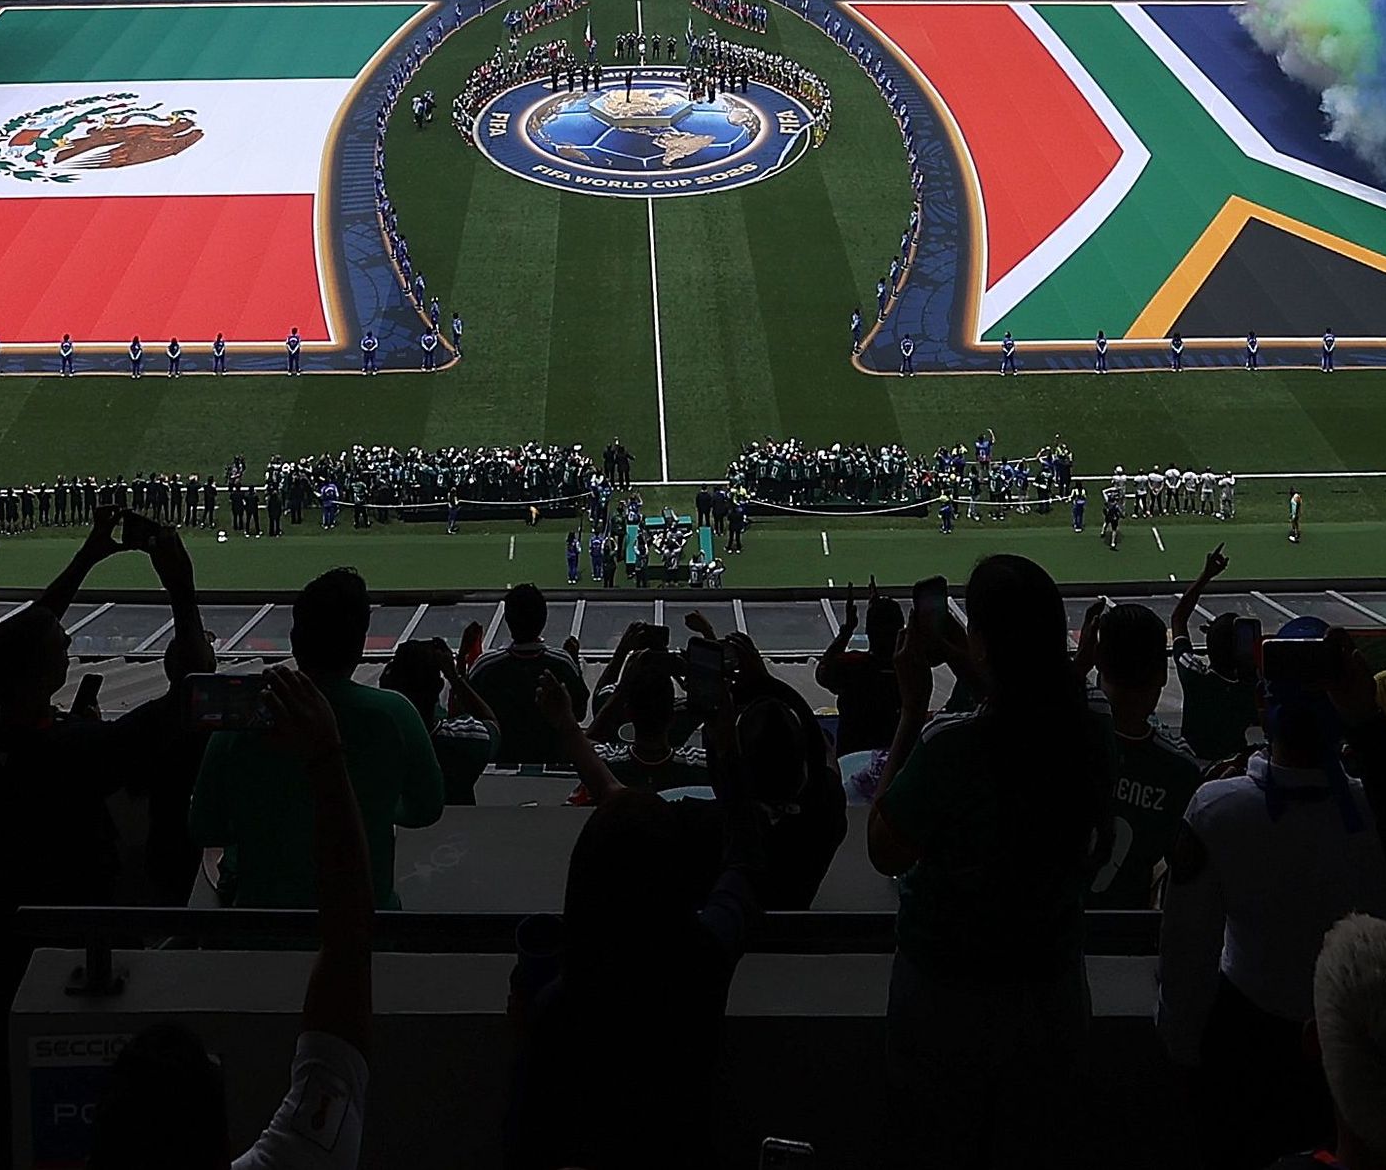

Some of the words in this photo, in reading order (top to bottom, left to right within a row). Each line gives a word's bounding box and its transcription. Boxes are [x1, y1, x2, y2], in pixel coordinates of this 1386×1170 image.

[489, 111, 511, 139] FIFA
[778, 109, 801, 135] FIFA
[532, 164, 572, 183] FIFA
[574, 175, 649, 191] WORLD
[652, 177, 694, 190] CUP
[694, 161, 758, 187] 2026
[1112, 777, 1167, 812] ENEZ
